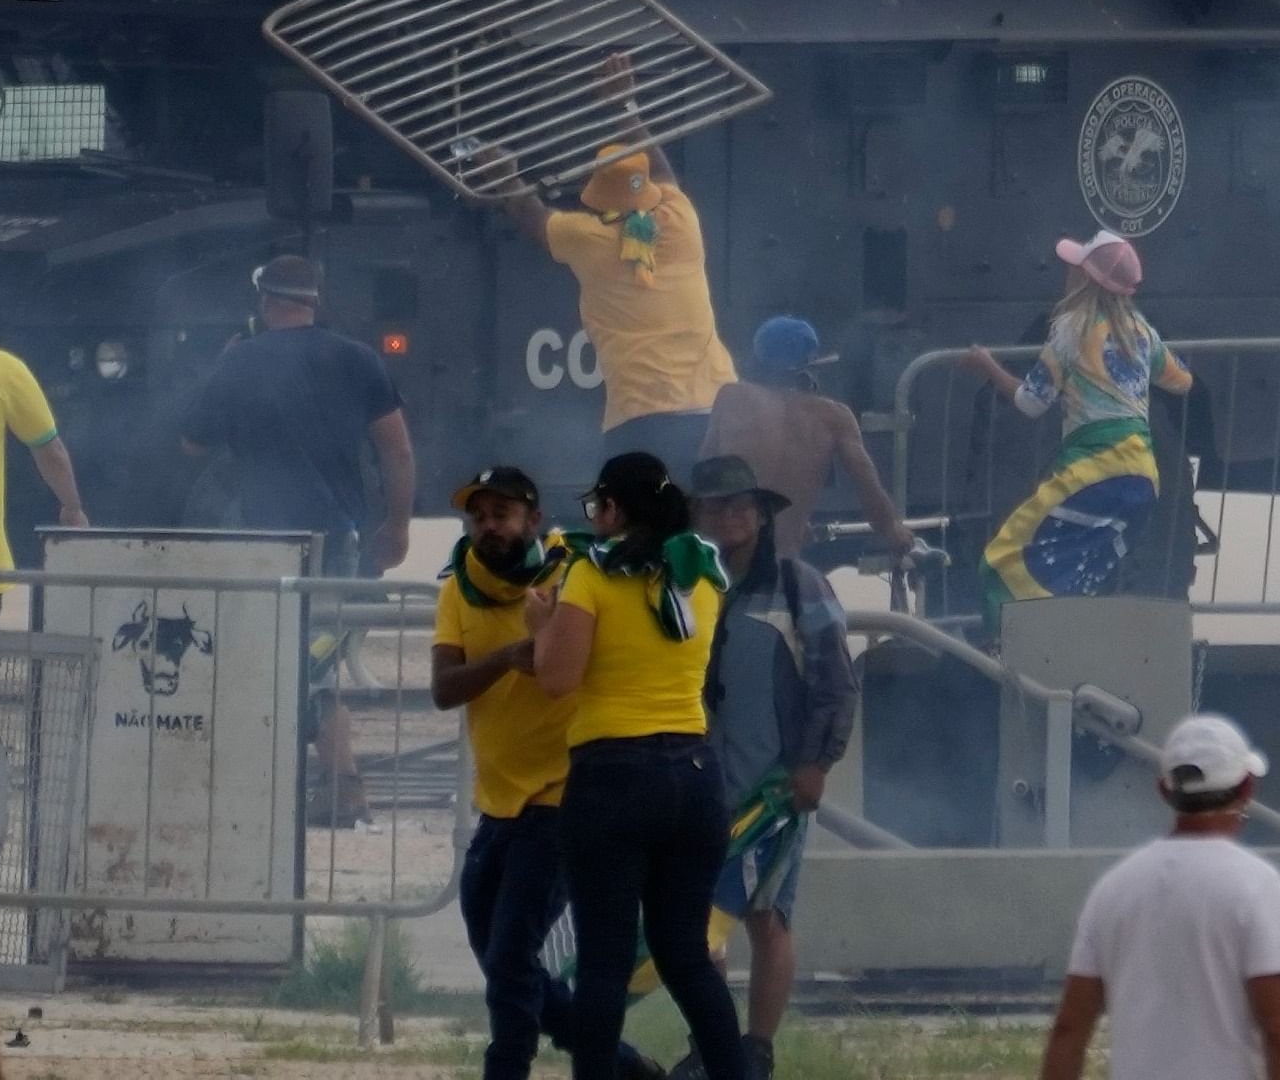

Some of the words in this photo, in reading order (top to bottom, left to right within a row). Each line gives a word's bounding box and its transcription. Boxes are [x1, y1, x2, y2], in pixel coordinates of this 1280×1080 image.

[1096, 96, 1111, 114] DE
[1121, 218, 1144, 232] COT
[526, 328, 604, 390] CO
[157, 714, 203, 731] MATE
